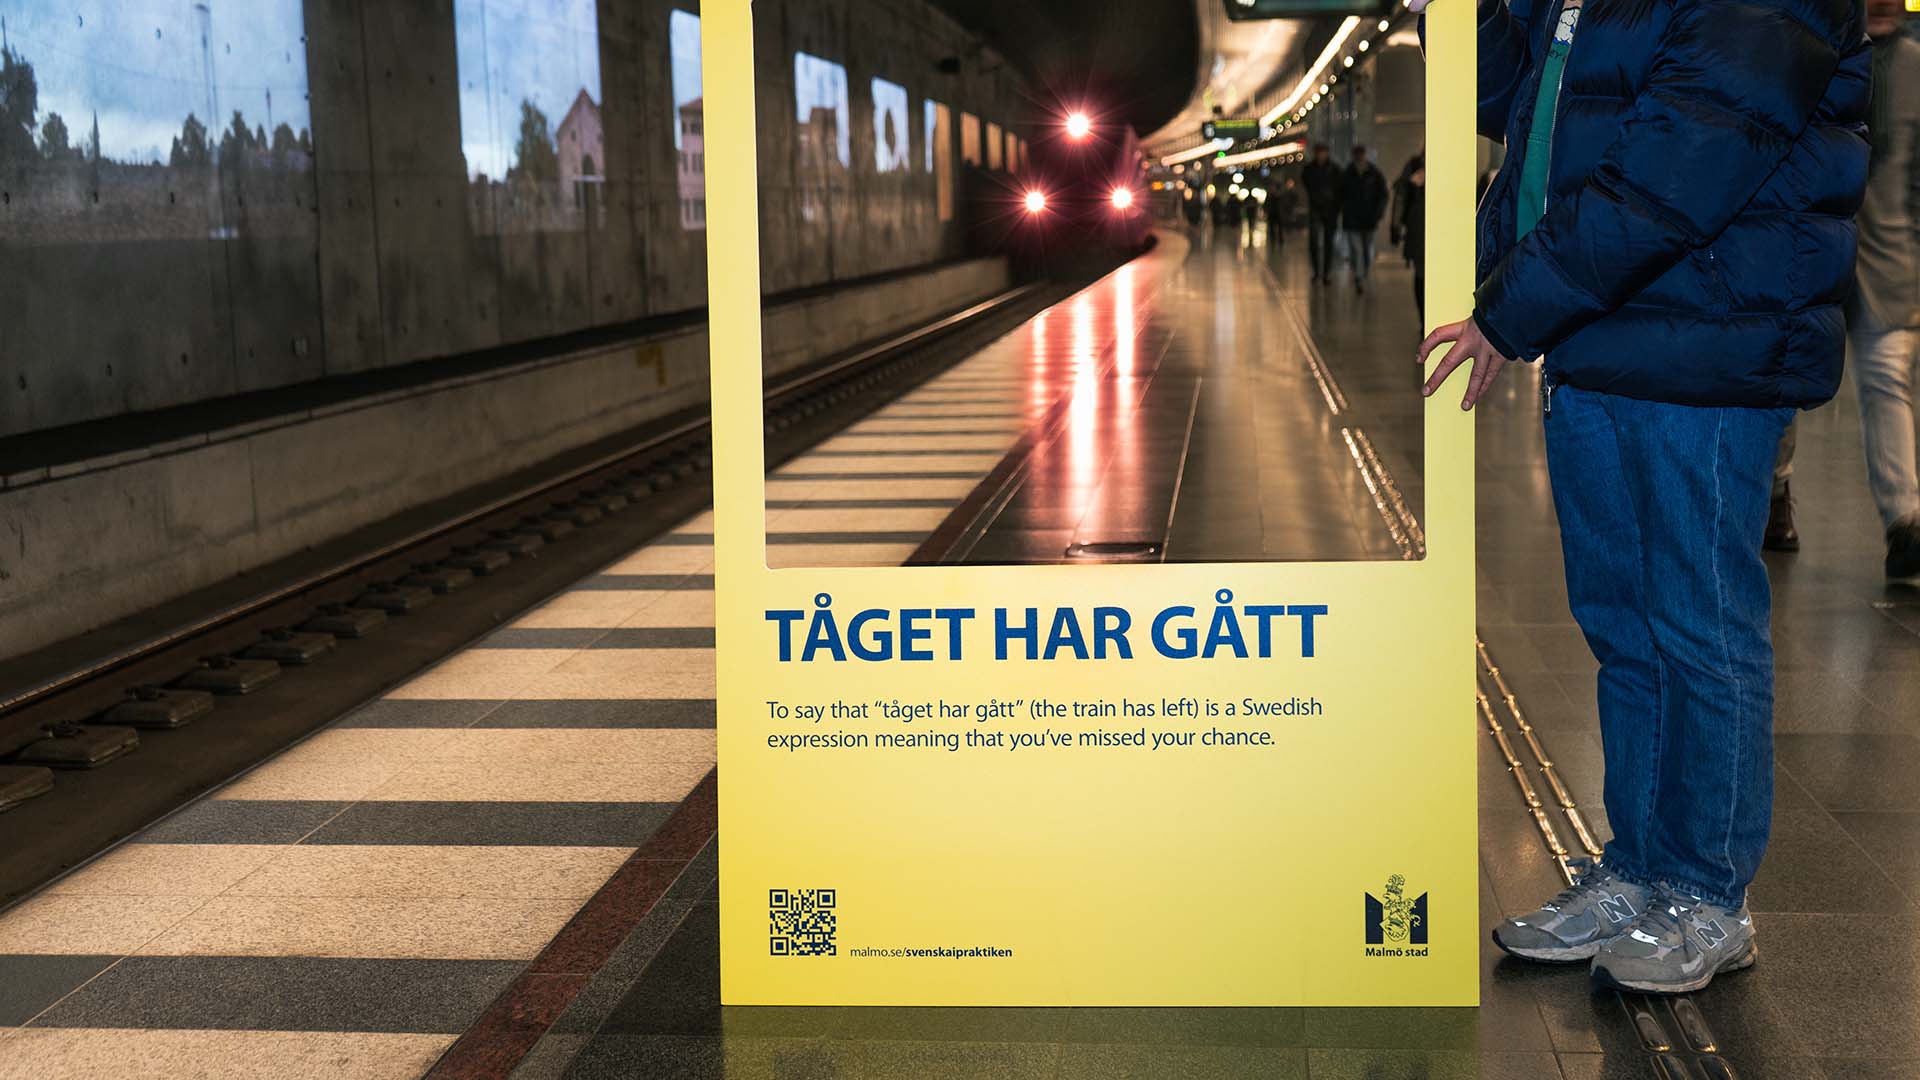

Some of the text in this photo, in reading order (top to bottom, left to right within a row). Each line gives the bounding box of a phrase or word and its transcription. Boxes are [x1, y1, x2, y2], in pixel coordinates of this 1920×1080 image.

[765, 588, 1328, 662] TÅGET HAR GÅTT
[766, 697, 1323, 723] To say that “tåget har gått” (the train has left) is a Swedish
[768, 727, 1276, 753] expression meaning that you’ve missed your chance.
[850, 947, 1012, 960] malmo.se/svenskaipraktiken
[1365, 947, 1428, 957] Malmö stad
